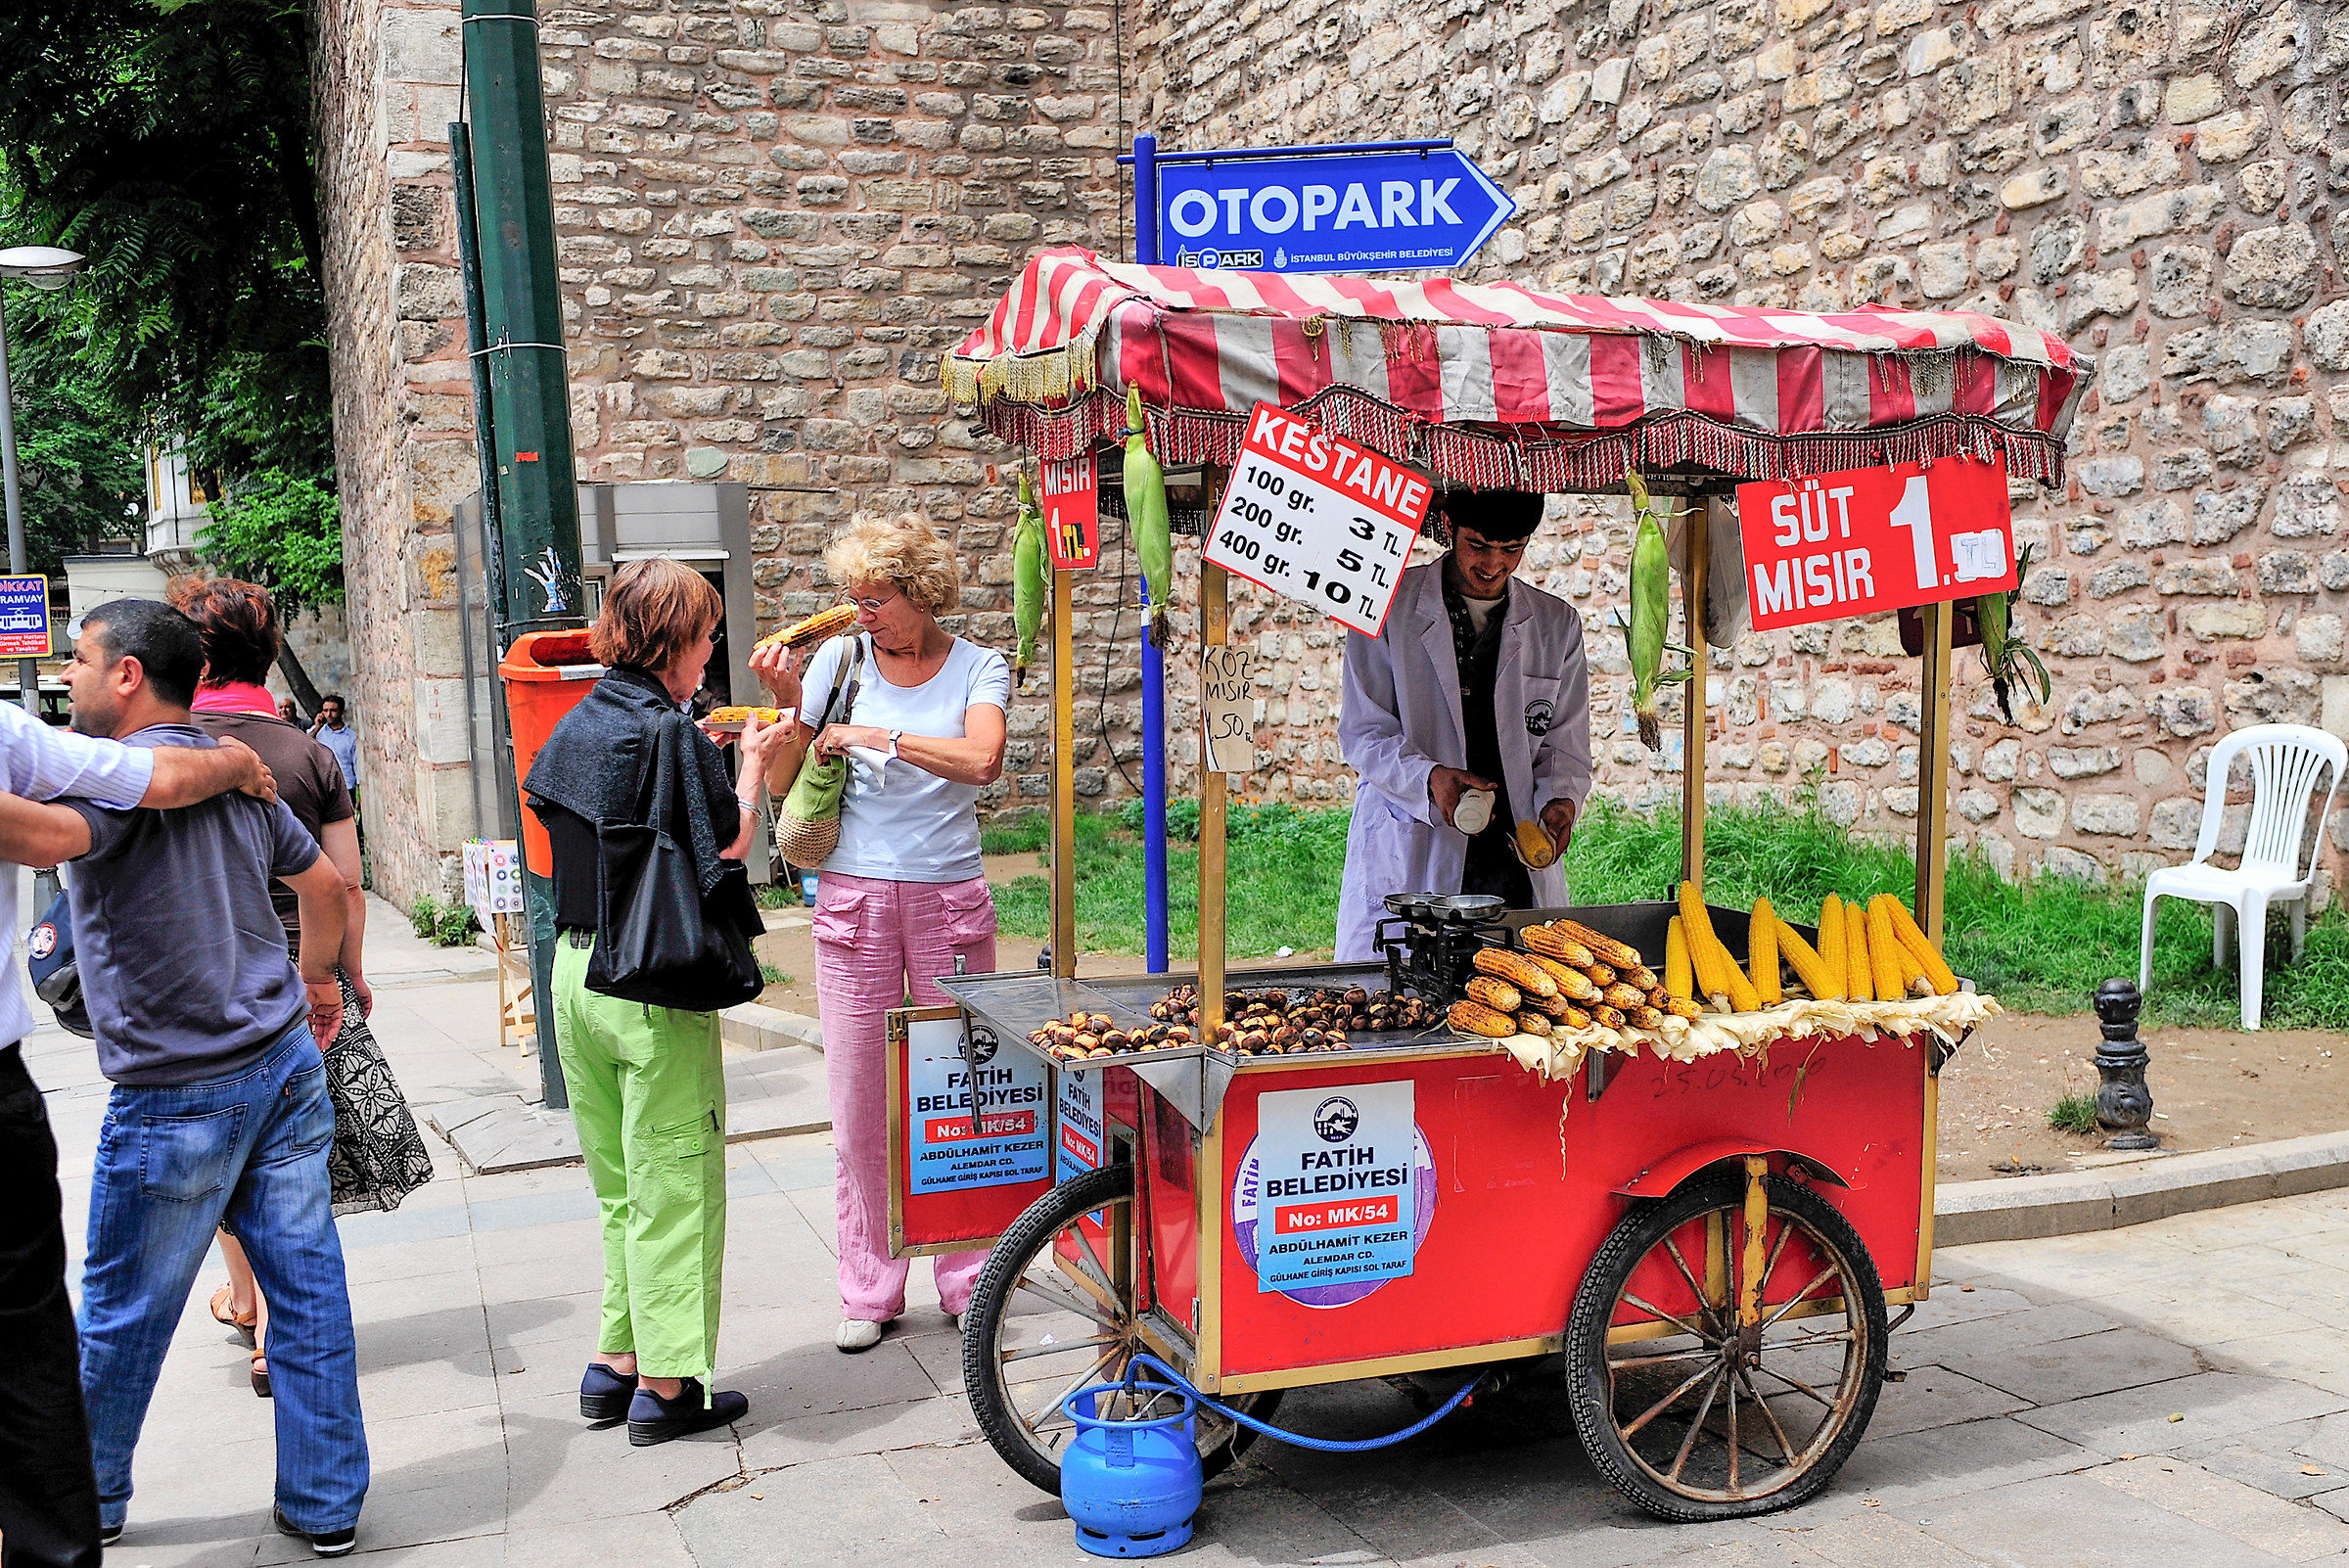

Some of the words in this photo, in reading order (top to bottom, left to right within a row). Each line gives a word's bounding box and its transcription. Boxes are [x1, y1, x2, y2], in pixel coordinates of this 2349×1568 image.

[1169, 177, 1463, 237] OTOPARK
[1291, 253, 1335, 263] İSTANBUL
[1338, 250, 1397, 261] BÜYÜKŞEHİR
[1400, 246, 1453, 258] BELEDİYESİ
[1044, 457, 1091, 496] MISIR
[1252, 409, 1427, 520] KESTANE
[1248, 465, 1285, 496] 100
[1287, 488, 1314, 513] gr.
[1349, 517, 1376, 541] 3
[1383, 531, 1401, 558] TL.
[1770, 480, 1854, 547] SÜT
[1231, 496, 1272, 529] 200
[1274, 521, 1303, 545] gr.
[1336, 548, 1364, 573] 5
[1370, 563, 1389, 588] TL.
[1960, 537, 1996, 569] TL
[1220, 530, 1260, 561] 400
[1263, 553, 1290, 577] gr.
[1303, 569, 1352, 604] 10
[1358, 594, 1377, 622] TL.
[1753, 547, 1875, 616] MISIR
[0, 594, 43, 604] RAMVAY
[1205, 646, 1254, 680] KÖZ
[1206, 680, 1254, 702] MISIR
[947, 1065, 1013, 1088] FATİH
[1651, 1057, 1826, 1097] 25.05.00
[916, 1082, 1043, 1112] BELEDİYESİ
[1068, 1083, 1090, 1111] FATİH
[1059, 1097, 1101, 1139] BELEDİYESİ
[920, 1143, 1001, 1161] ABDÜLHAMİT
[1004, 1140, 1044, 1153] KEZER
[950, 1159, 996, 1171] ALEMDAR
[1301, 1143, 1374, 1171] FATİH
[921, 1175, 956, 1185] GÜLHANE
[980, 1171, 1002, 1179] KAPISI
[1021, 1166, 1043, 1175] TARAF
[1267, 1163, 1407, 1197] BELEDİYESİ
[1288, 1213, 1321, 1228] No:
[1327, 1204, 1388, 1223] MK/54
[1268, 1234, 1360, 1255] ABDÜLHAMİT
[1363, 1231, 1407, 1244] KEZER
[1303, 1253, 1355, 1265] ALEMDAR
[1358, 1251, 1374, 1260] CD.
[1270, 1271, 1309, 1282] GÜLHANE
[1312, 1268, 1333, 1277] GİRİŞ
[1335, 1266, 1361, 1275] KAPISI
[1363, 1264, 1379, 1272] SOL
[1381, 1261, 1406, 1270] TARAF
